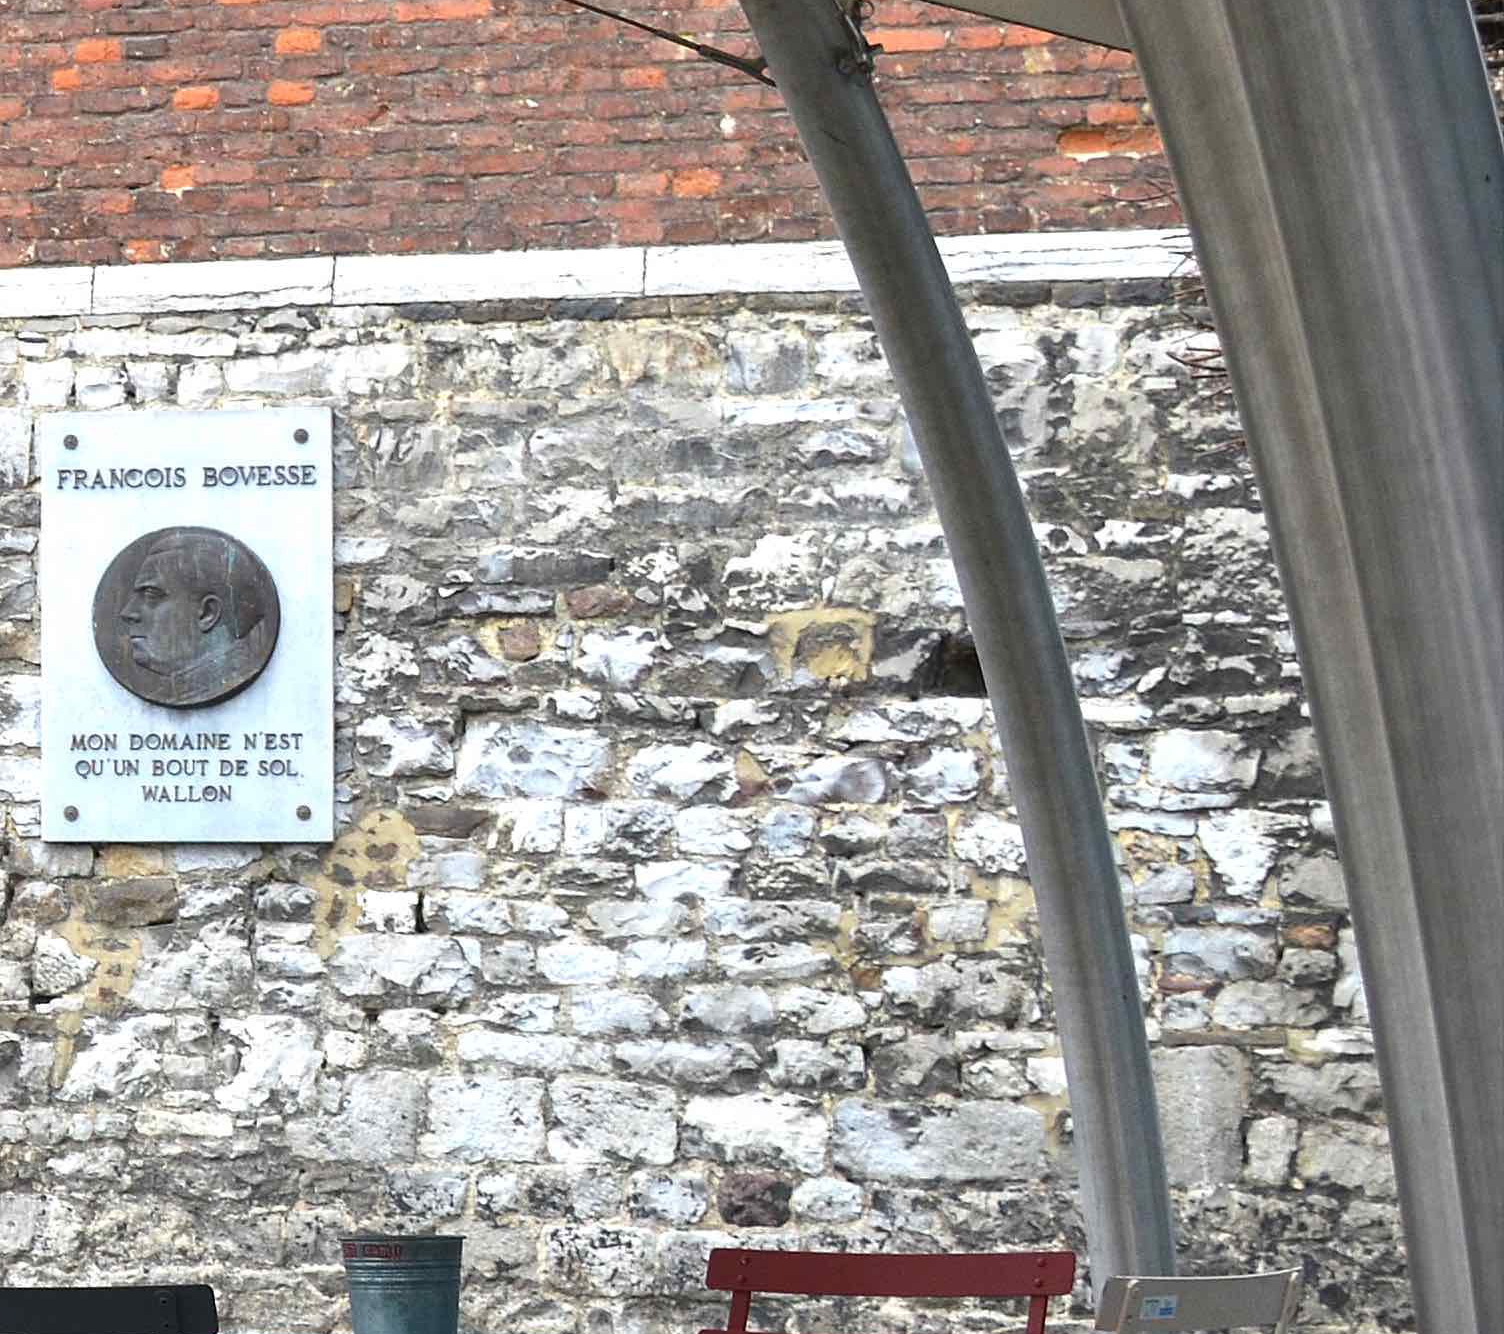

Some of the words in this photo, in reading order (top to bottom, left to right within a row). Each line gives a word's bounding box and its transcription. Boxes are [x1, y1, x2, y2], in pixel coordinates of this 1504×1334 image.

[202, 464, 317, 488] BOVESSE
[70, 733, 118, 752] MON
[129, 733, 231, 751] DOMAINE
[243, 731, 304, 751] N'EST
[75, 759, 139, 780] QU'UN
[152, 759, 209, 777] BOUT
[219, 759, 248, 777] DE
[141, 784, 232, 803] WALLON
